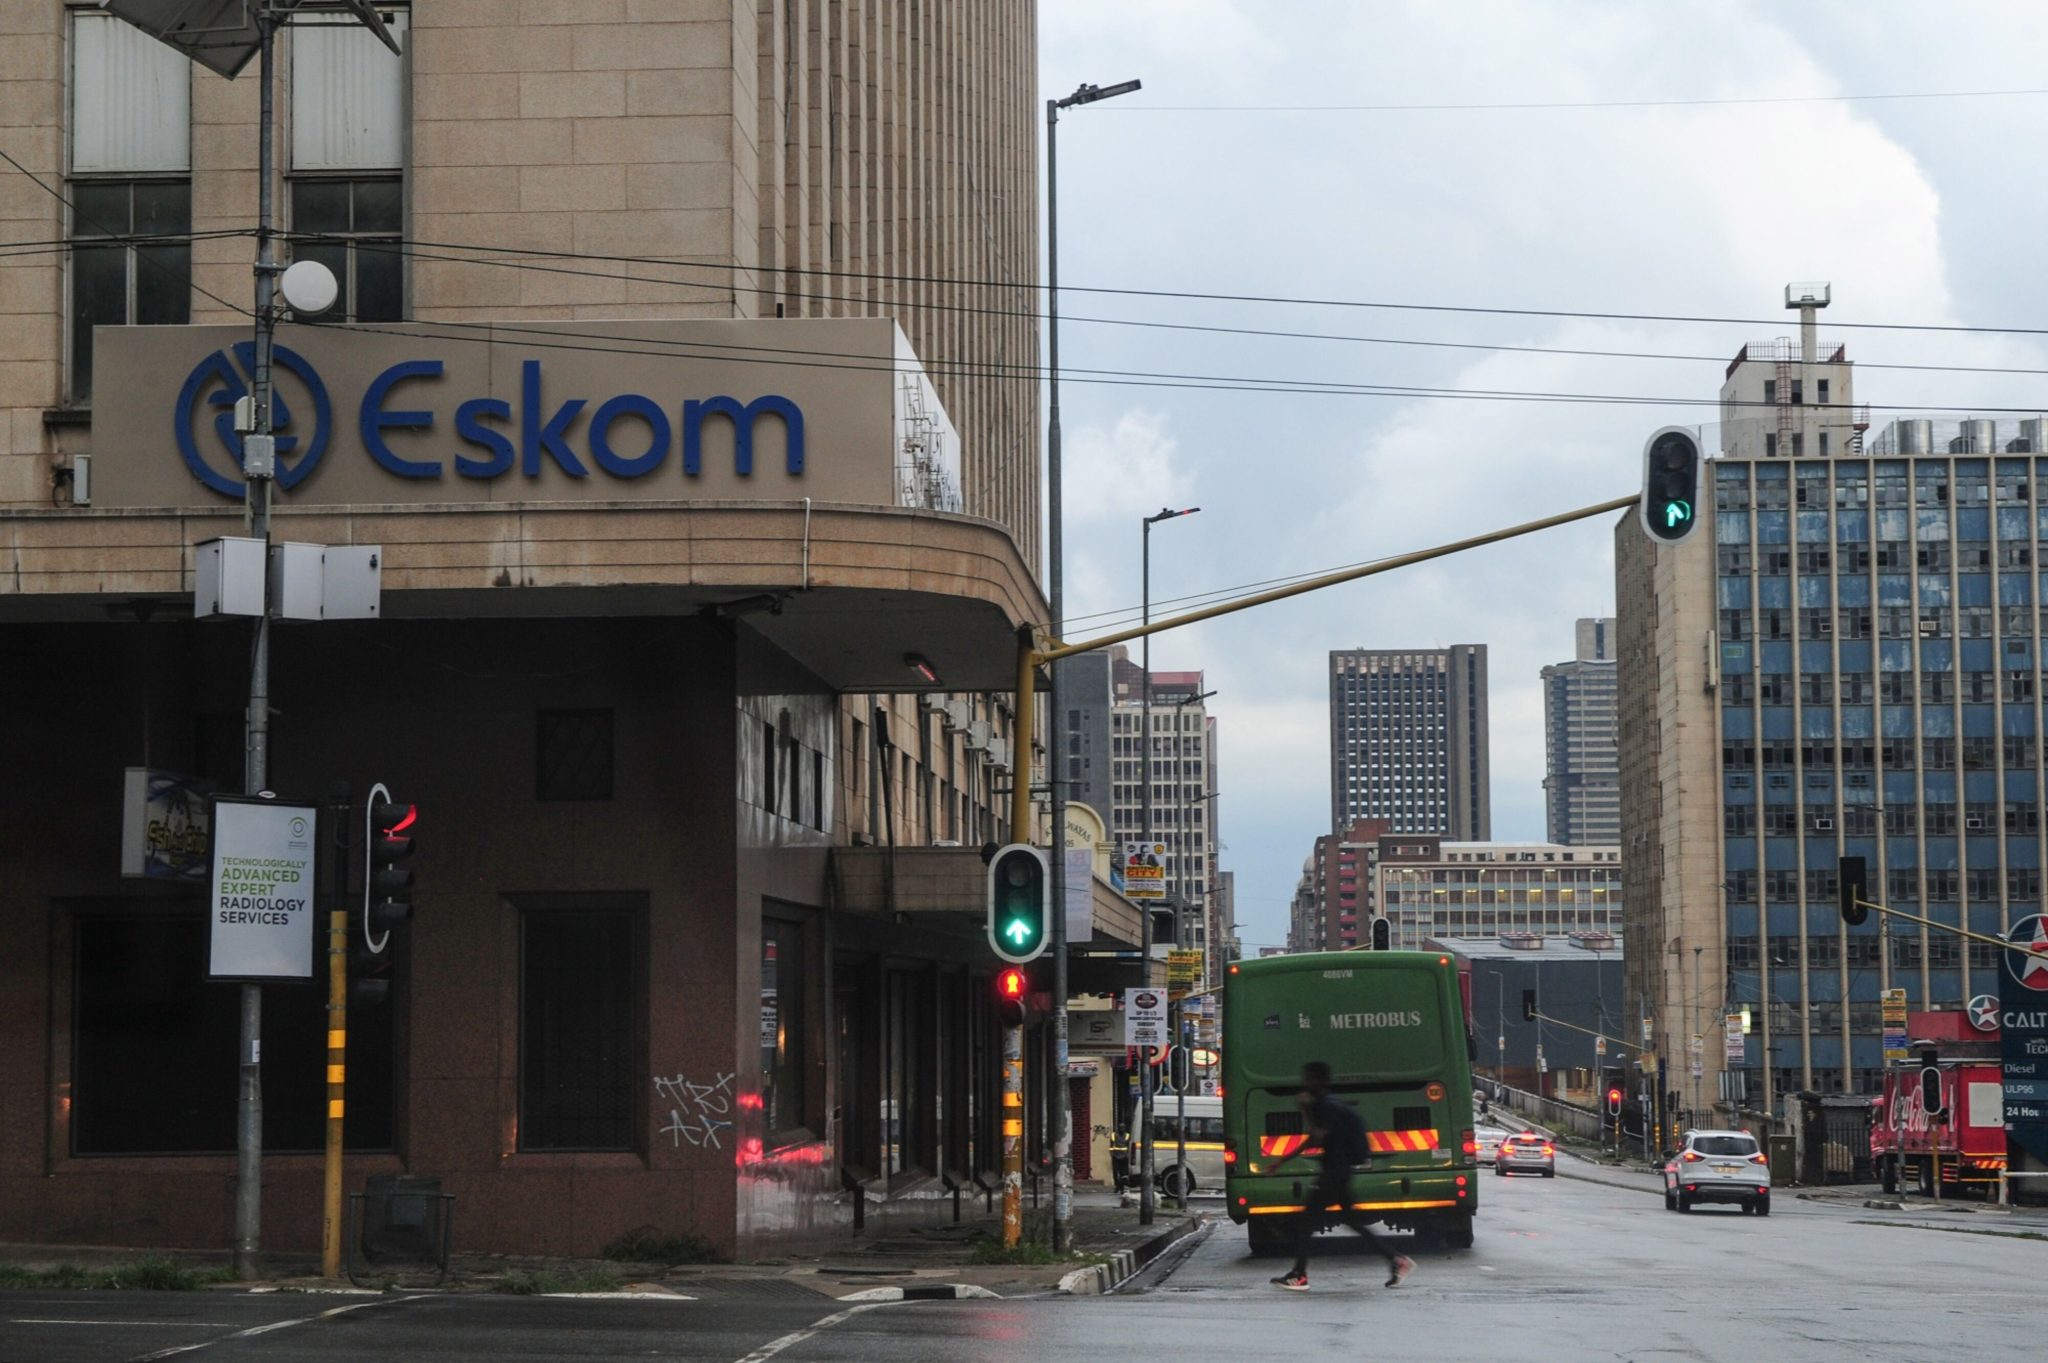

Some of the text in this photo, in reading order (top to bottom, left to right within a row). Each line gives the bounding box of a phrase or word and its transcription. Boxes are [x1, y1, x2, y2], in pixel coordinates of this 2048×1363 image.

[360, 358, 805, 478] Eskom
[221, 856, 307, 869] TECHNOLOGICALLY
[220, 867, 301, 884] ADVANCED
[220, 882, 276, 896] EXPERT
[219, 896, 306, 912] RADIOLOGY
[219, 911, 289, 925] SERVICES
[1329, 1010, 1422, 1030] METROBUS
[2004, 1063, 2036, 1074] Diesel
[2004, 1084, 2034, 1094] ULP95
[2006, 1106, 2019, 1117] 24
